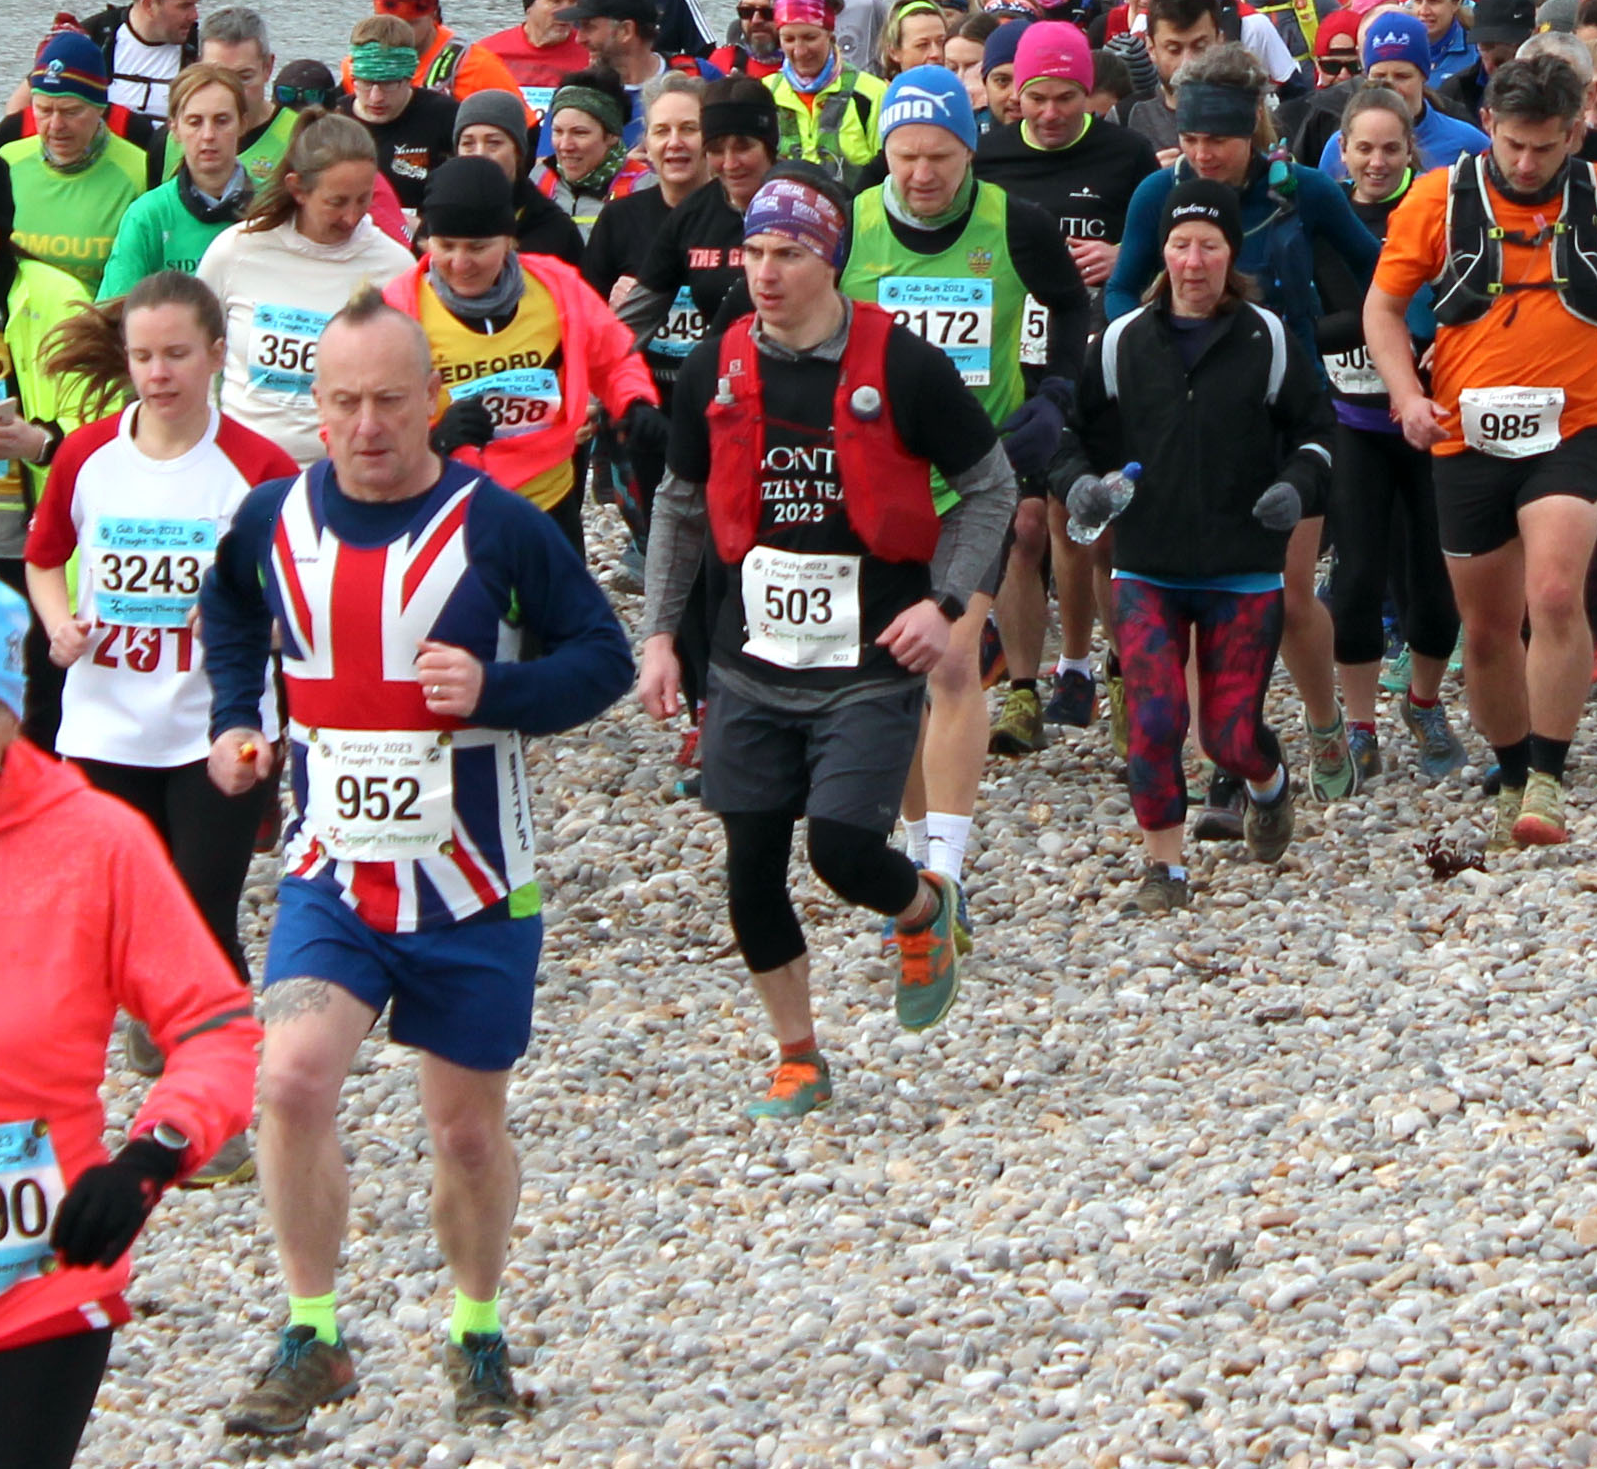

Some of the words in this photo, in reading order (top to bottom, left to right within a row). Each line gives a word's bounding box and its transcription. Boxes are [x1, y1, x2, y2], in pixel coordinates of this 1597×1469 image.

[1060, 217, 1105, 238] TIC
[688, 249, 721, 268] THE
[258, 334, 316, 373] 356
[1480, 413, 1541, 442] 985
[761, 446, 837, 474] ONT
[760, 479, 807, 500] ZZLY
[774, 503, 825, 523] 2023
[101, 553, 201, 595] 3243
[765, 584, 833, 625] 503
[383, 742, 413, 754] 2023
[335, 775, 423, 822] 952
